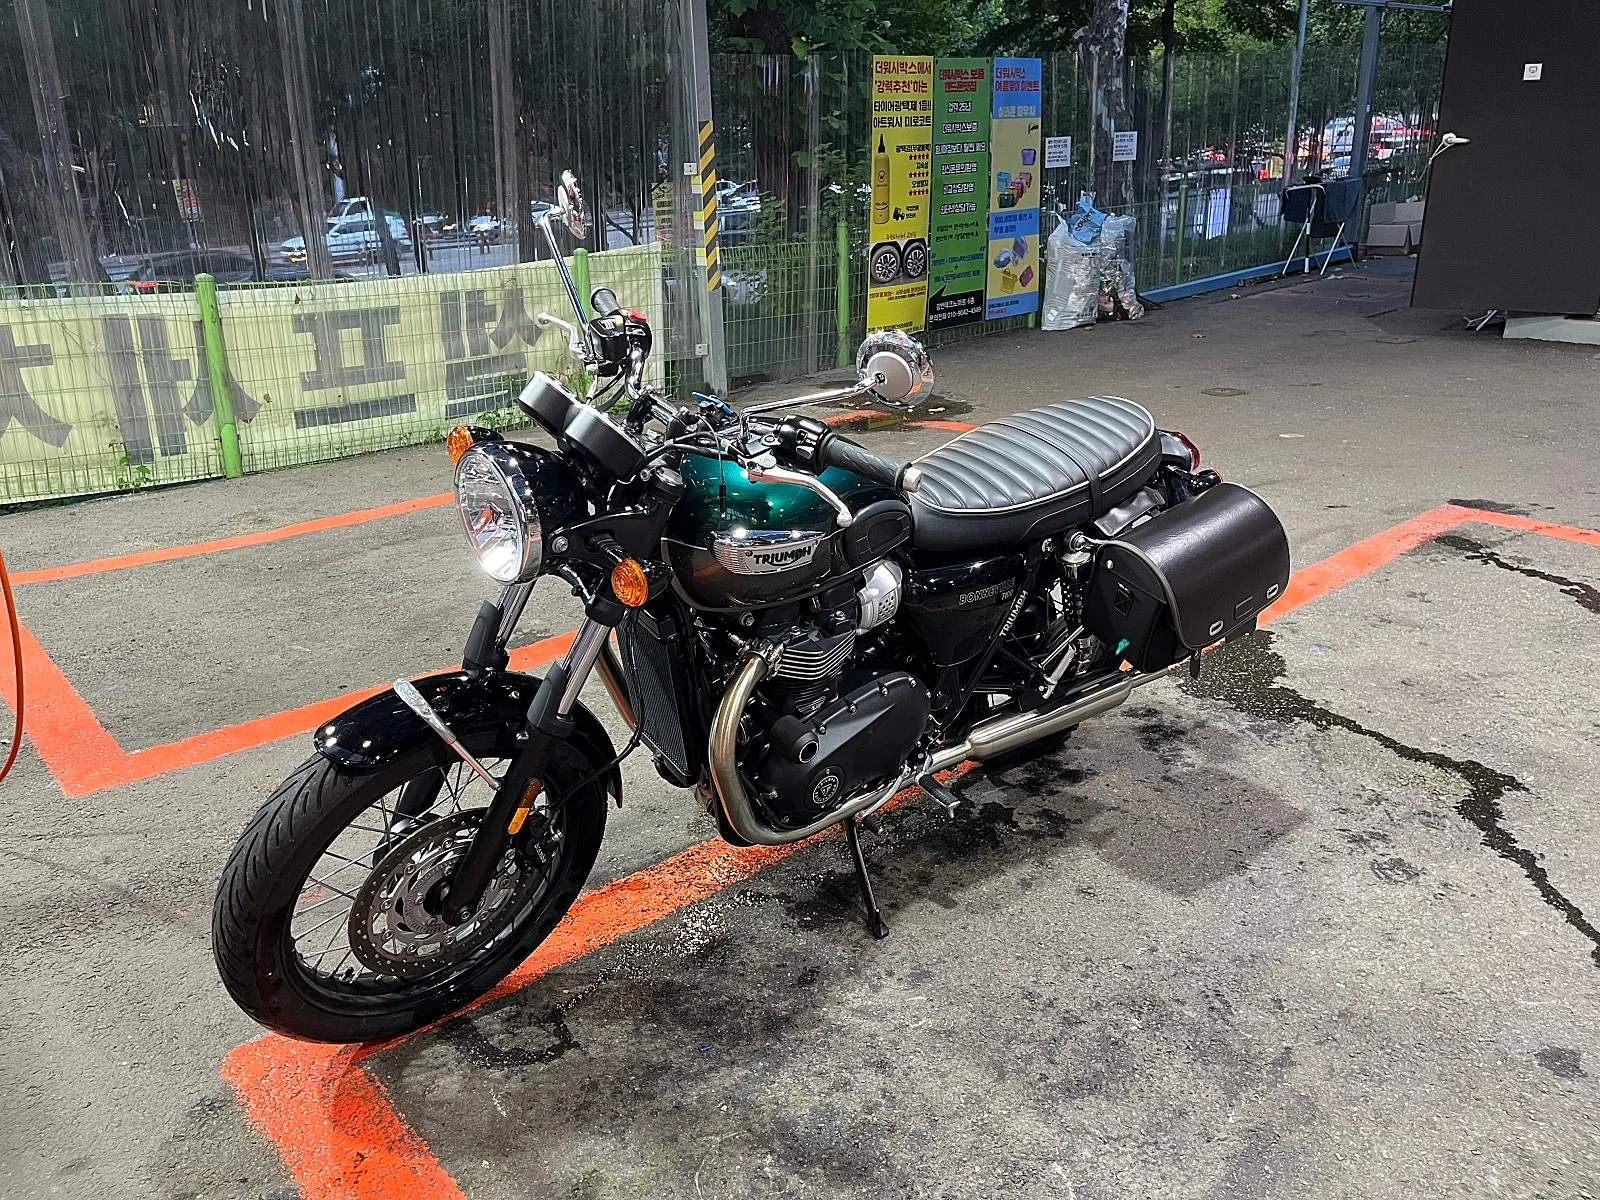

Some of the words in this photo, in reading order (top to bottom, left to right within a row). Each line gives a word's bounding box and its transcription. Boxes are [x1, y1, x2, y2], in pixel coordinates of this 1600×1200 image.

[876, 61, 931, 74] 더워시박스에서
[995, 67, 1026, 79] 더워시박스
[875, 80, 928, 93] '강력추천'하는
[1021, 81, 1040, 92] 이벤트
[874, 100, 917, 112] 타이어광택제
[1017, 105, 1036, 117] 파우치
[873, 117, 903, 128] 아트워시
[904, 116, 931, 127] 미로코트
[941, 202, 977, 215] 인터넷상담가능
[929, 312, 947, 323] 문의전화
[753, 545, 812, 566] TRIUMPH
[959, 577, 1016, 606] BONNEVILLE
[999, 590, 1028, 637] TRIUMPH
